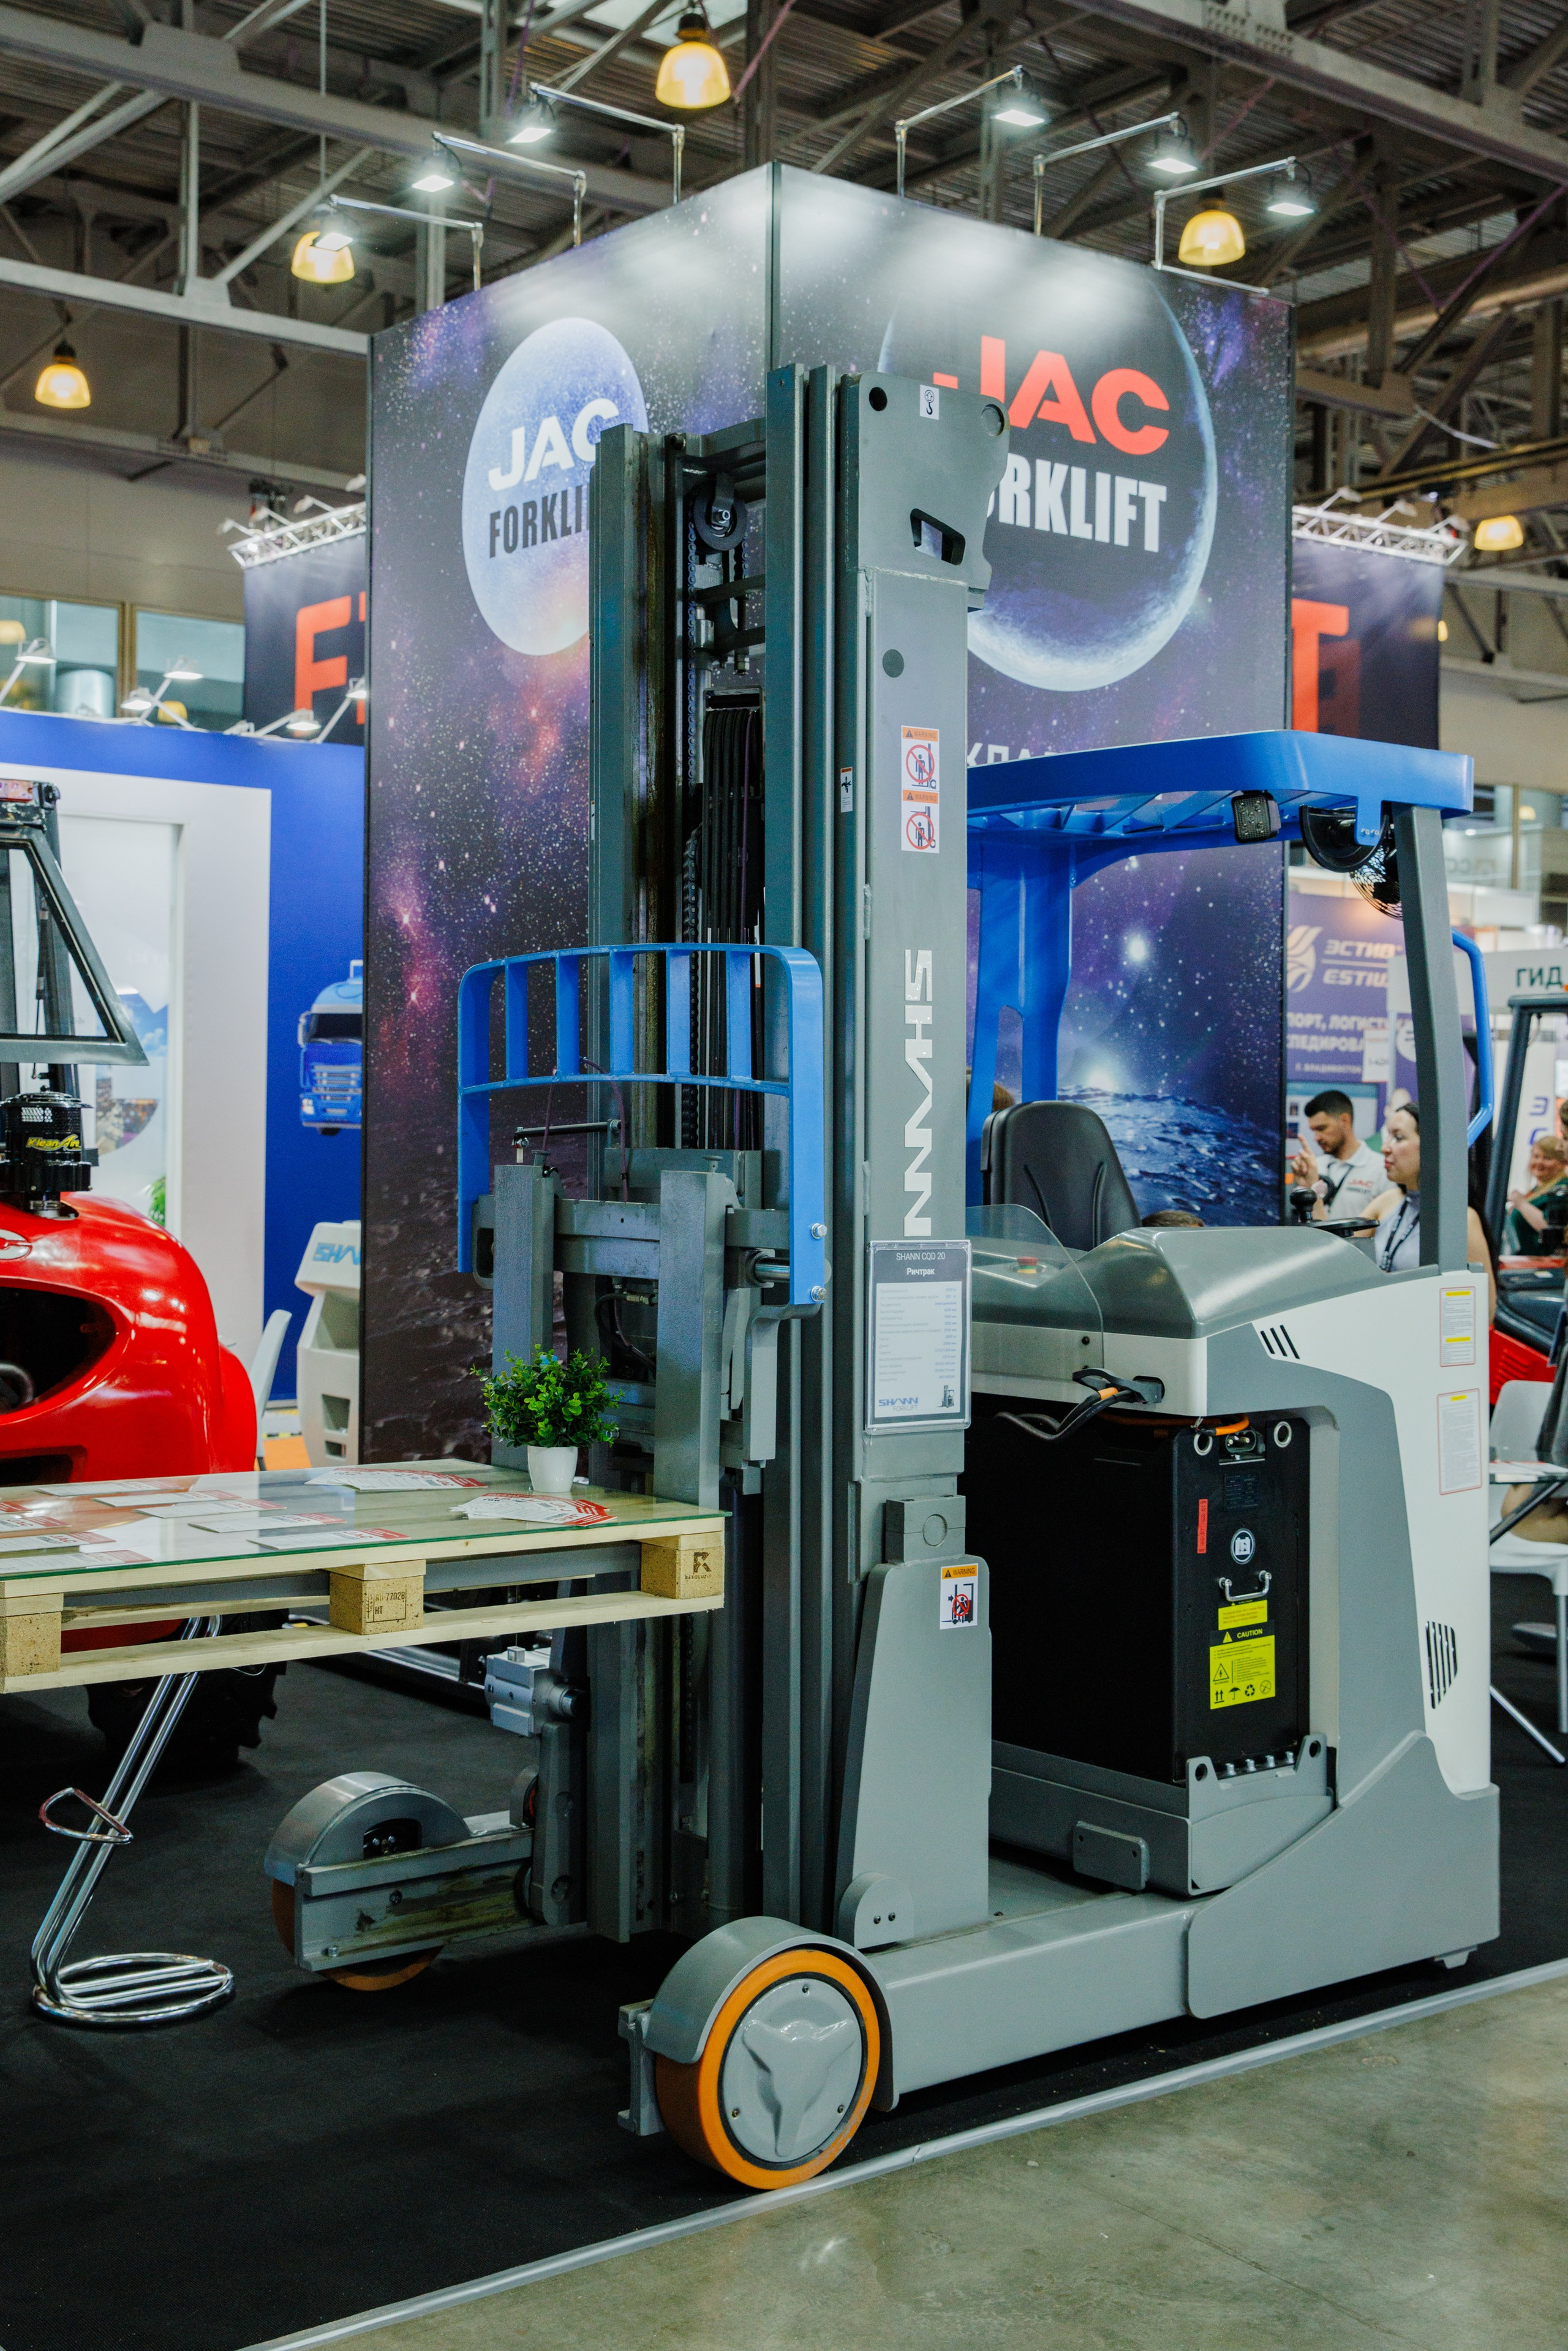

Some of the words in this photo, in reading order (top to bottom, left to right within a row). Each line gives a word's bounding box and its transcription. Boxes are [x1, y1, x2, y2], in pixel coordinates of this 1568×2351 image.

[488, 398, 619, 491] JAC
[987, 452, 1167, 553] RKLIFT
[489, 482, 590, 558] FORKLI
[904, 949, 932, 1237] SHANN
[921, 1252, 936, 1261] CQD
[937, 1251, 946, 1260] 20
[907, 1267, 935, 1277] Ричтрак
[952, 1567, 975, 1576] WARNING
[375, 1606, 383, 1615] HT
[1237, 1628, 1264, 1639] CAUTION
